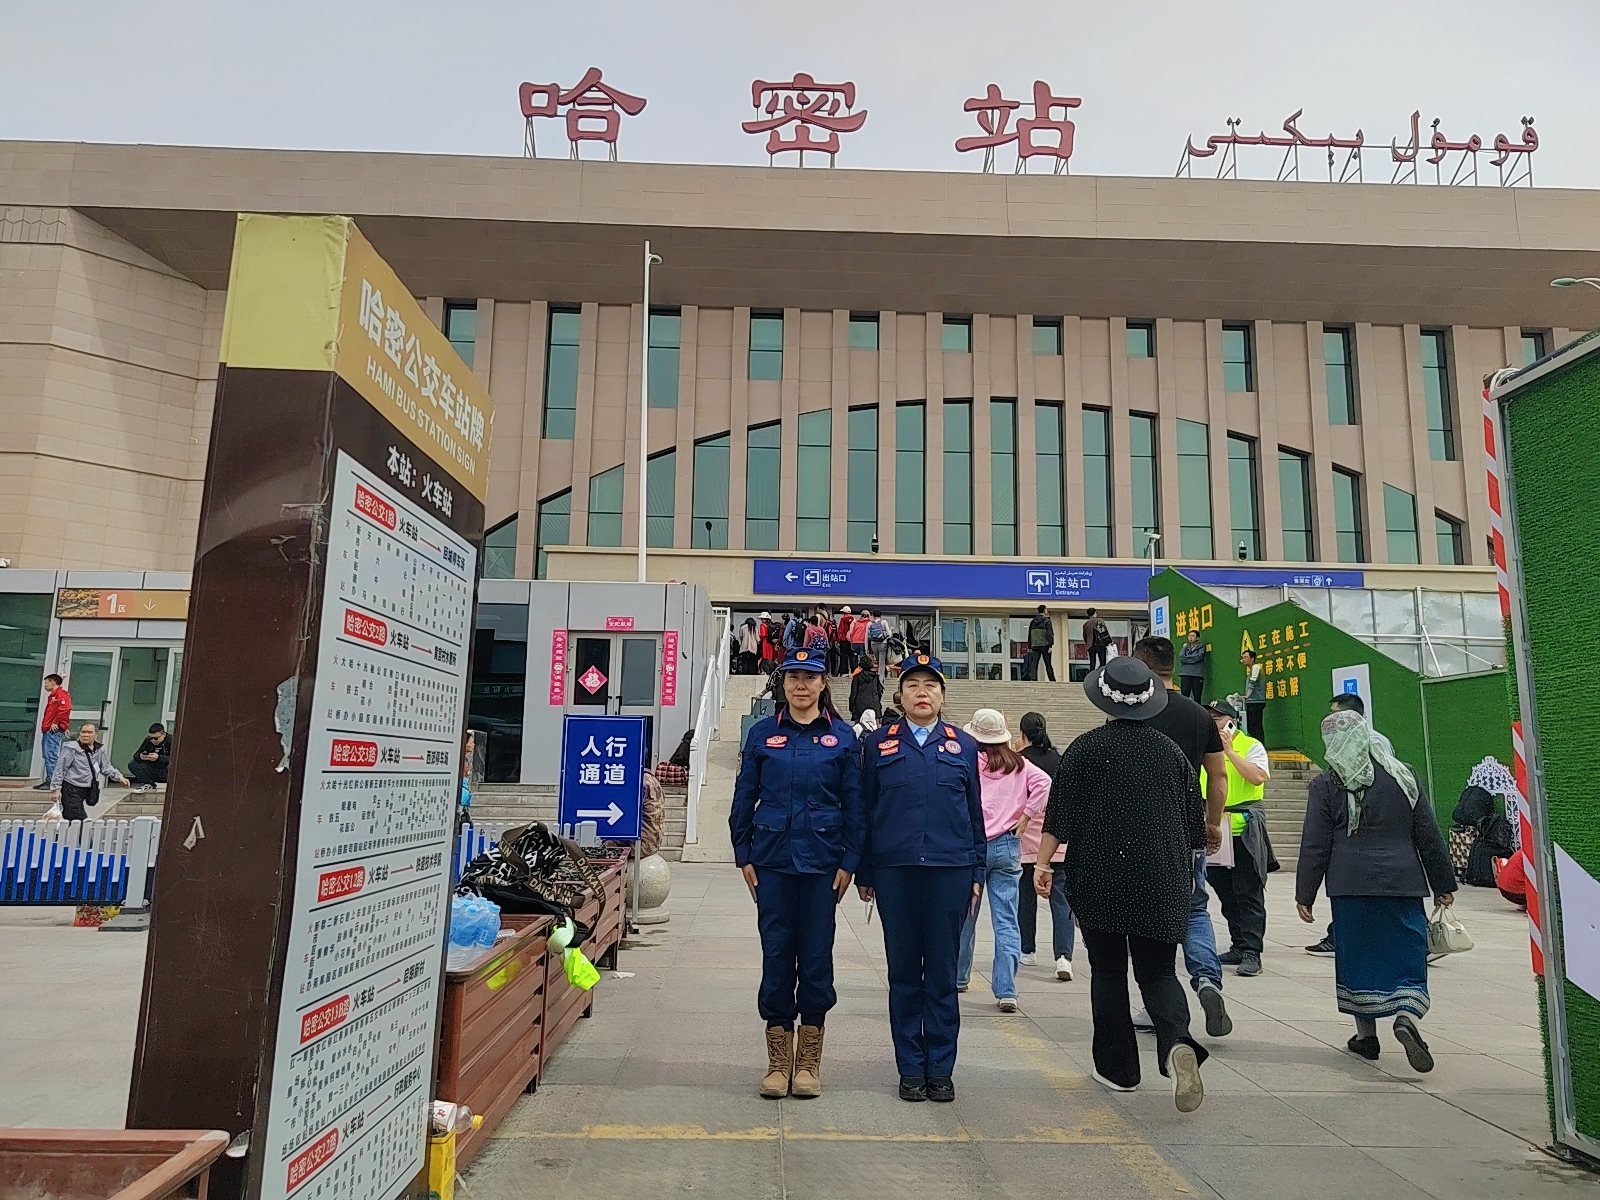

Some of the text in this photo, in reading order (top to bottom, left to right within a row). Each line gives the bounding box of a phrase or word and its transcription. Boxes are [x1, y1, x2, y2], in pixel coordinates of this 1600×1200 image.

[519, 67, 1082, 158] 哈密站
[360, 278, 486, 453] 哈密公交车站牌
[366, 355, 476, 476] HAMI BUS STATION SIGN
[357, 489, 396, 528] 哈密公交1路
[1055, 577, 1090, 589] 进站口
[346, 613, 386, 643] 哈密公交2路
[1176, 604, 1213, 637] 进站口
[1259, 621, 1309, 650] 正在施工
[1246, 652, 1307, 676] 带来不便
[332, 744, 377, 764] 哈密公交3路
[580, 735, 627, 758] 人行
[578, 763, 626, 785] 通道
[319, 871, 365, 899] 哈密公交12路
[289, 1134, 338, 1185] 哈密公交22路
